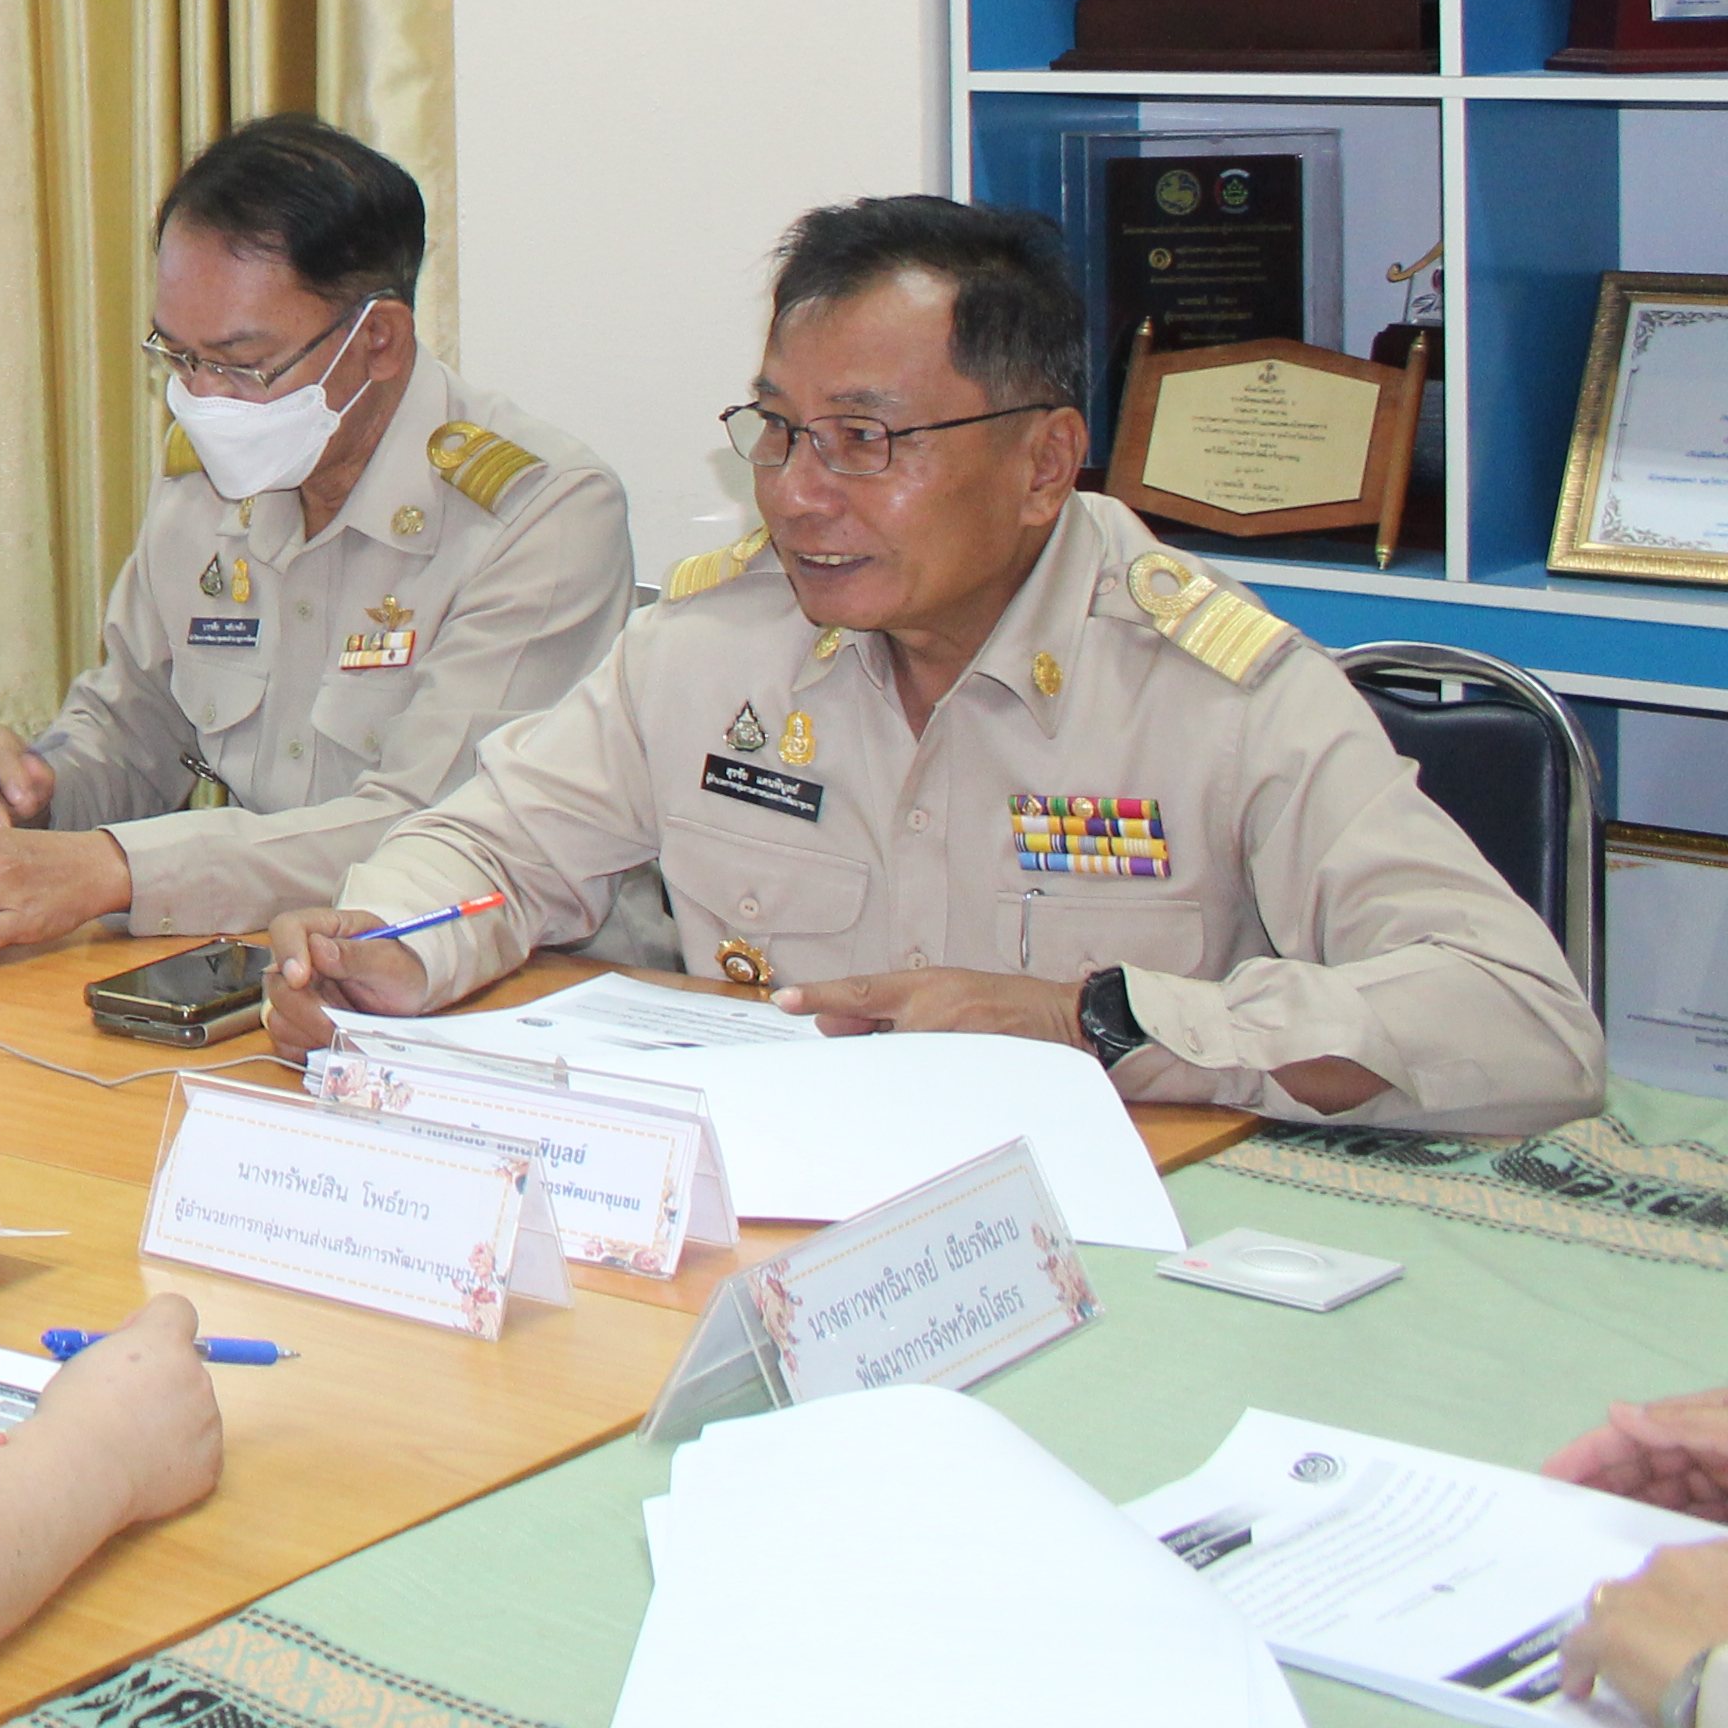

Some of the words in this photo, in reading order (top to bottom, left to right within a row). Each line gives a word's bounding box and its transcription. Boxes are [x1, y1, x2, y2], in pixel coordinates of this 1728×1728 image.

[237, 1160, 349, 1203] นางทรัพย์สิน
[174, 1196, 477, 1284] ผู้อำนวยการกลุ่มงานส่งเสริมการพัฒนาชุมชน
[855, 1284, 1025, 1389] พัฒนาการจังหวัดยโสธร
